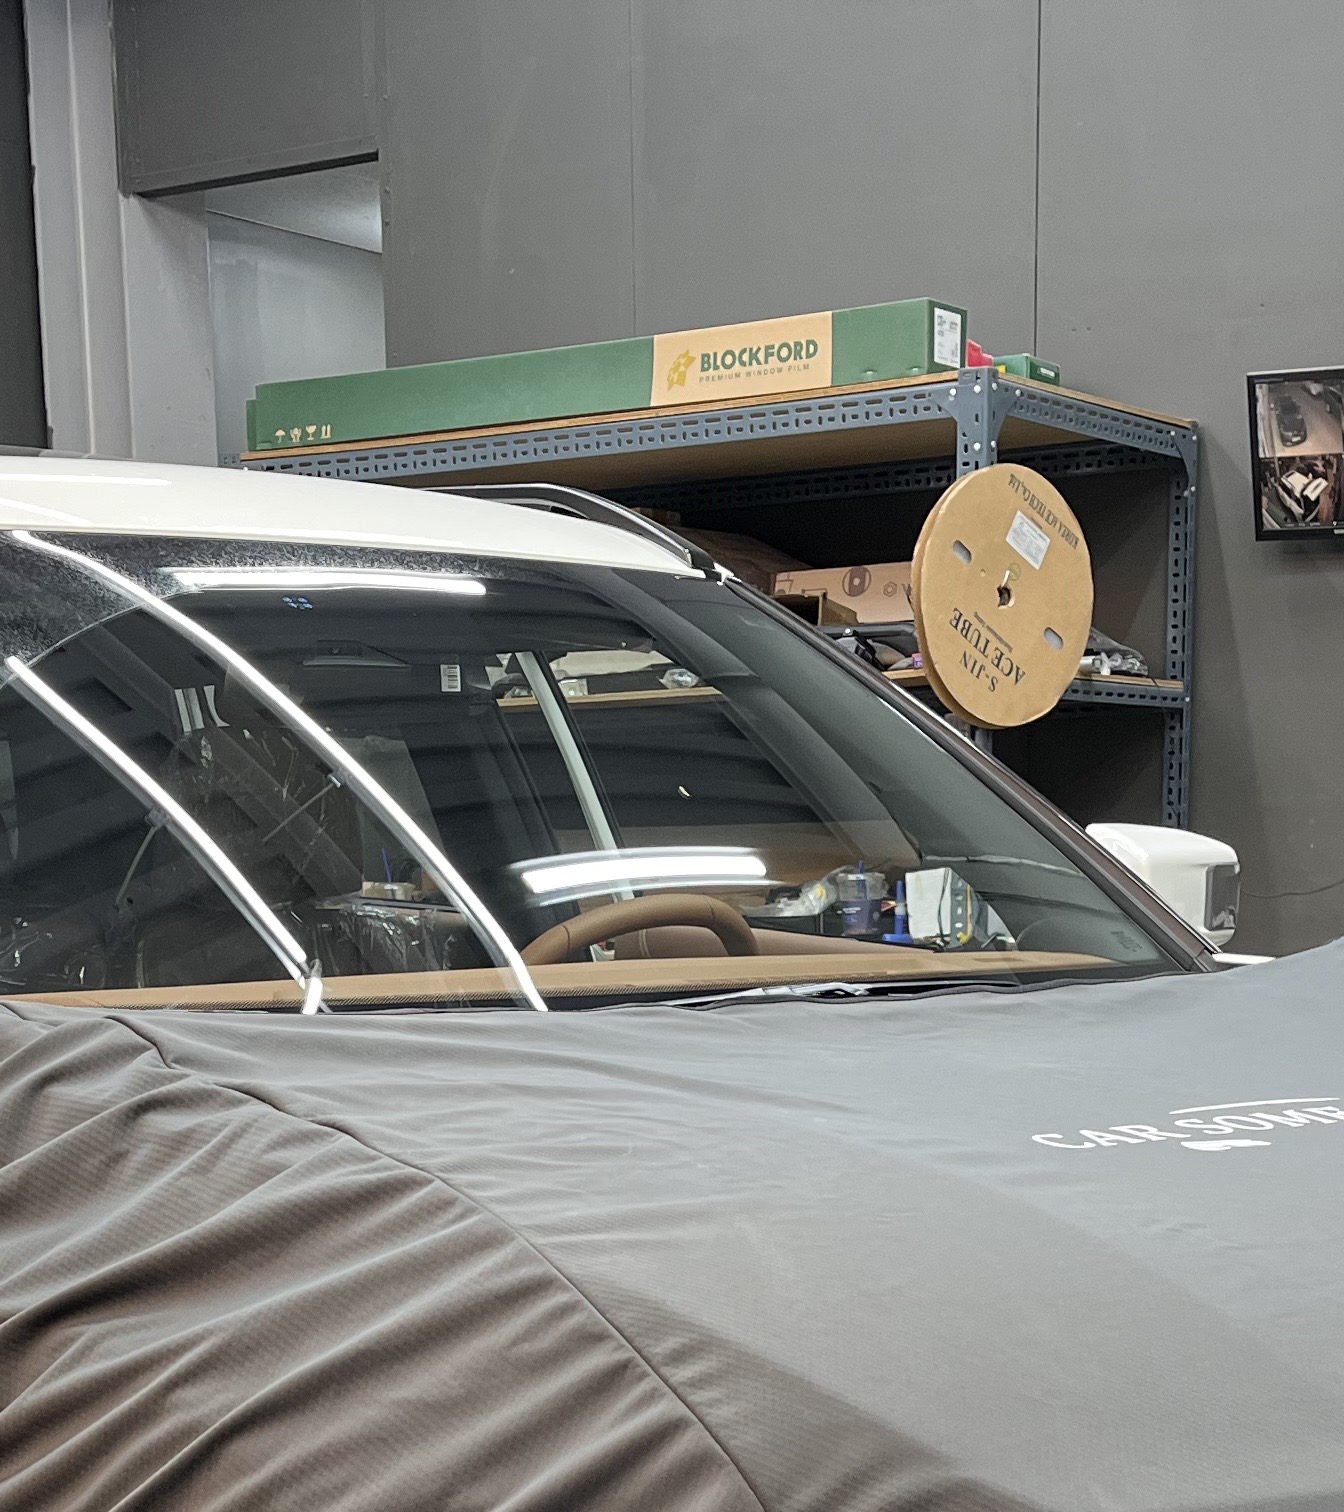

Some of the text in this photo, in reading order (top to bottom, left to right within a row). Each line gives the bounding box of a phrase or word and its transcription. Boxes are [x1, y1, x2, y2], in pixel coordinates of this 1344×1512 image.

[698, 363, 810, 384] PREMIUM WINDOW FILM
[700, 338, 819, 372] BLOCKFORD
[949, 607, 991, 659] TUBE
[958, 650, 999, 693] S-JIN
[990, 646, 1027, 686] ACE
[1030, 1122, 1193, 1150] CAR
